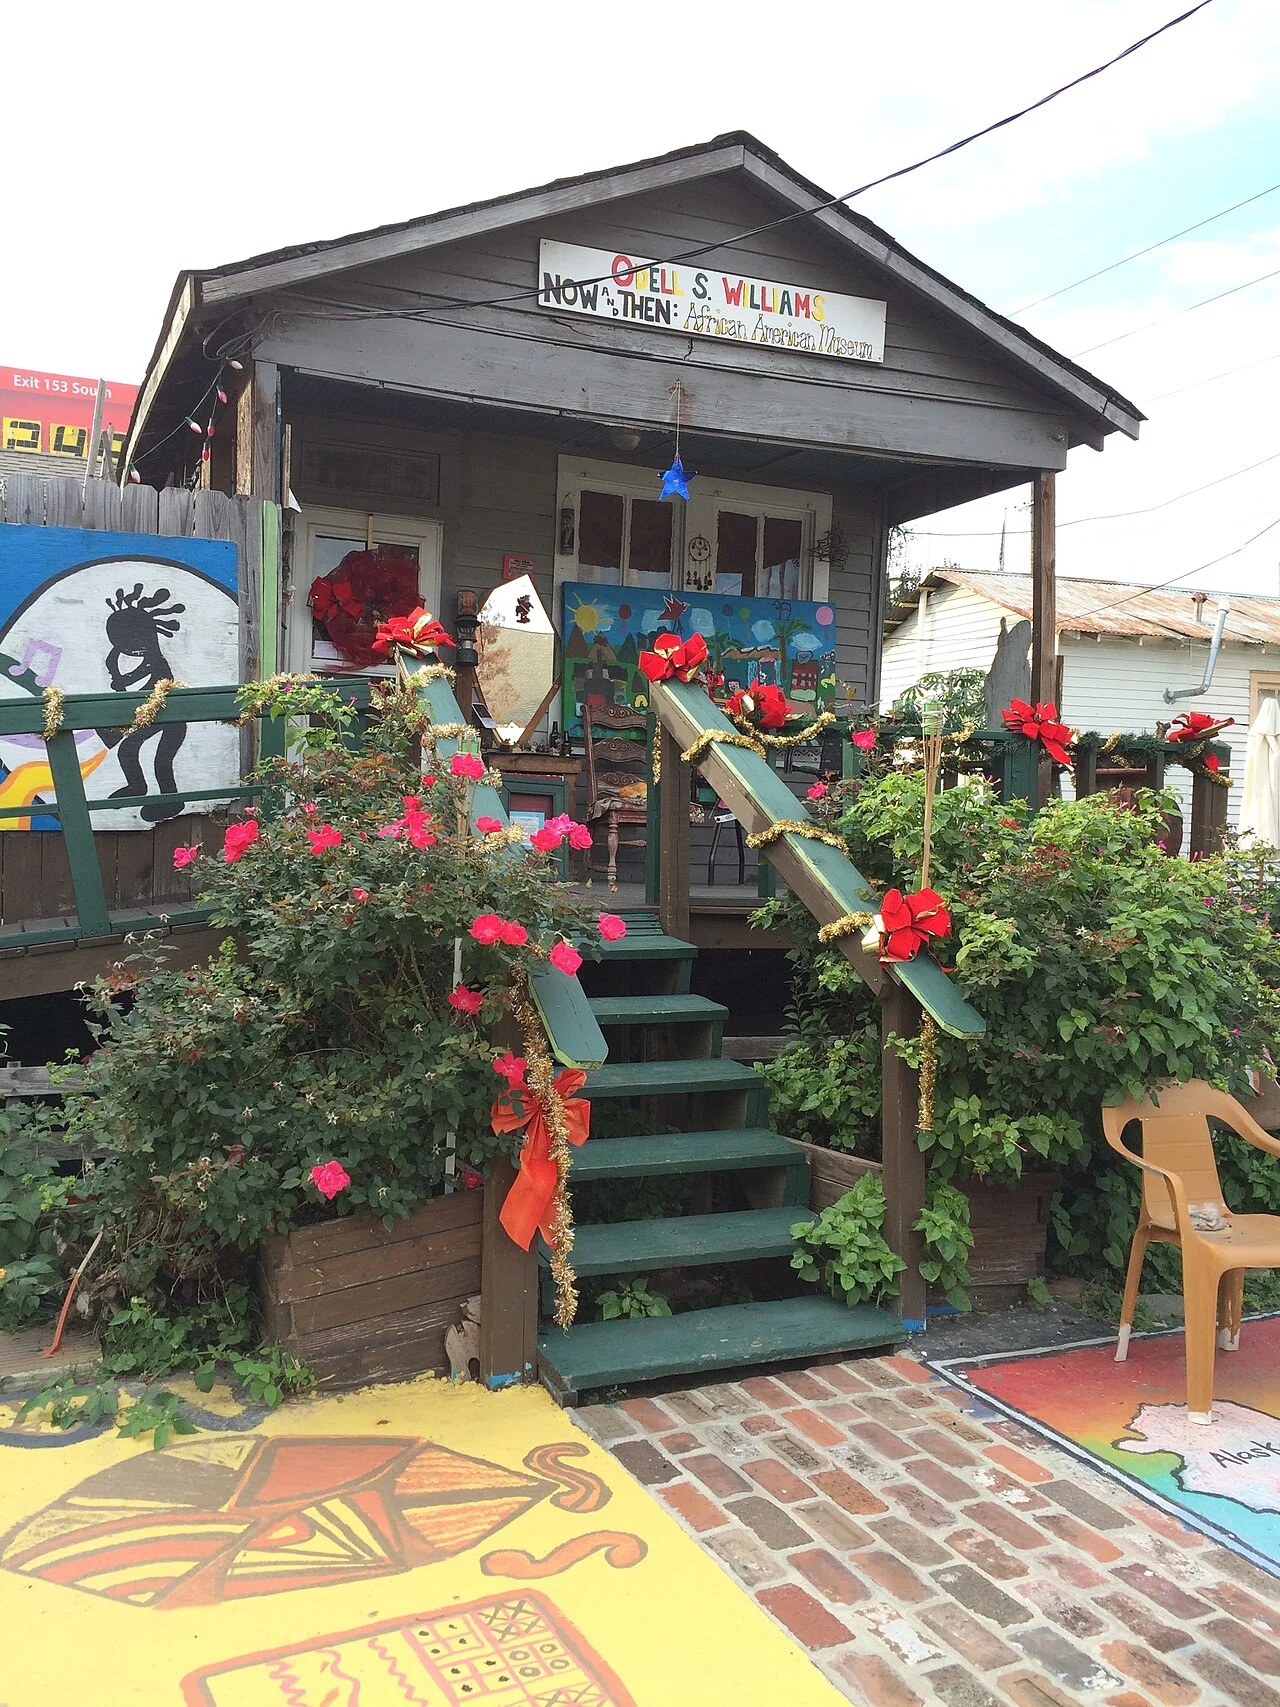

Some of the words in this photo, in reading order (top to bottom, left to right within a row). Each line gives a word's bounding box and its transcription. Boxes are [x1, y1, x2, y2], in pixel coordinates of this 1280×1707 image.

[543, 271, 599, 312] NOW
[617, 289, 679, 325] THEN:
[683, 301, 748, 340] African
[750, 313, 816, 351] American
[818, 323, 874, 360] Museum
[611, 254, 684, 297] ODELL
[692, 272, 712, 300] S.
[721, 276, 826, 322] WILLIAMS
[13, 374, 40, 389] Exit
[43, 378, 69, 393] 153
[71, 382, 112, 398] Souh
